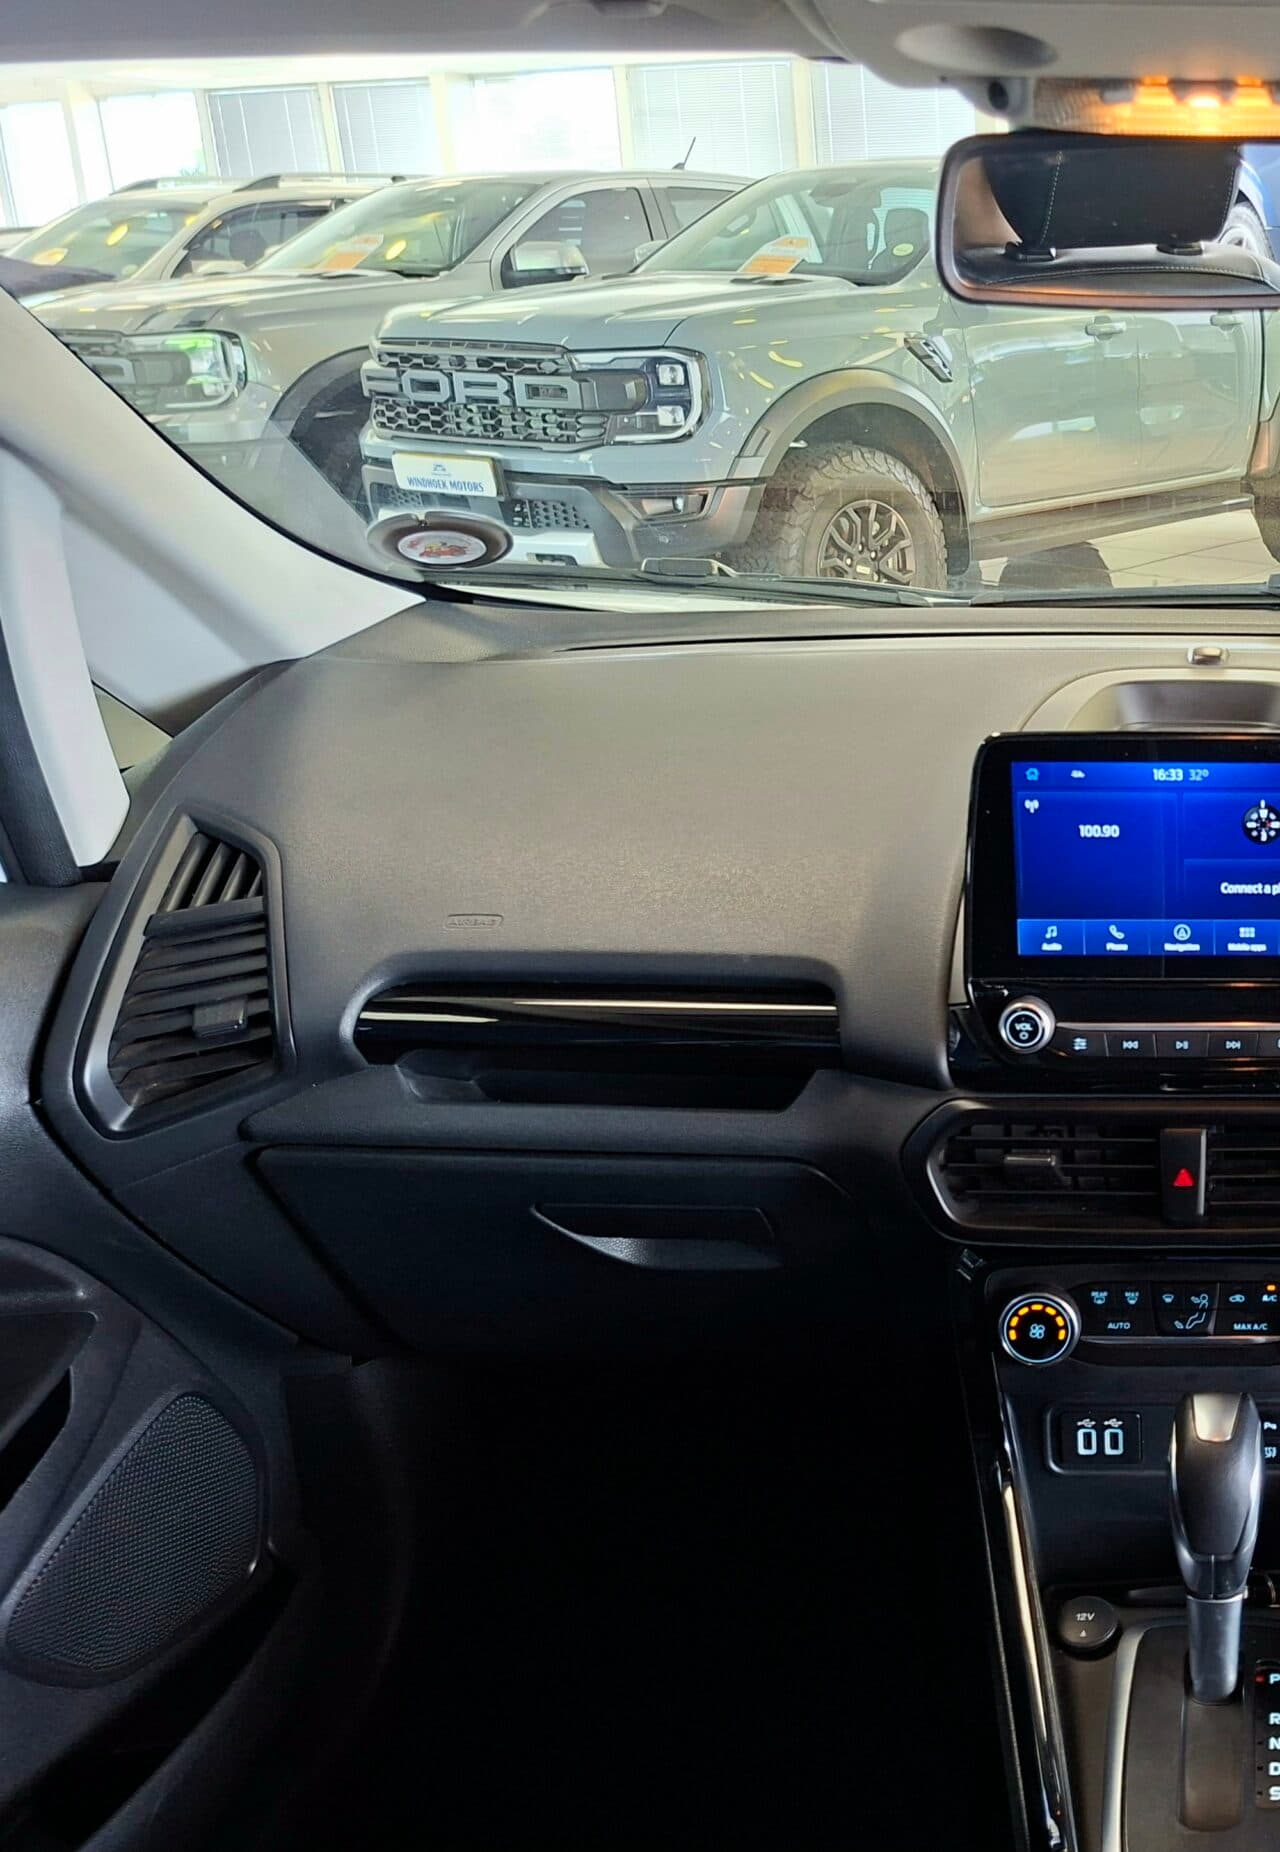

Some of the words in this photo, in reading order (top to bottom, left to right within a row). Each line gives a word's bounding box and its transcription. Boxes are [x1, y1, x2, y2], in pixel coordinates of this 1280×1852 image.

[360, 360, 582, 409] FORD
[407, 475, 449, 489] WINDHOEK
[449, 480, 484, 492] MOTORS
[1152, 768, 1184, 781] 16:33
[1079, 824, 1120, 838] 100.90
[1220, 882, 1262, 895] Connect
[1015, 1023, 1033, 1031] VOL
[1107, 1322, 1131, 1330] AUTO
[1233, 1323, 1252, 1331] MAX
[1252, 1323, 1268, 1331] A/C
[1075, 1612, 1095, 1621] 12V
